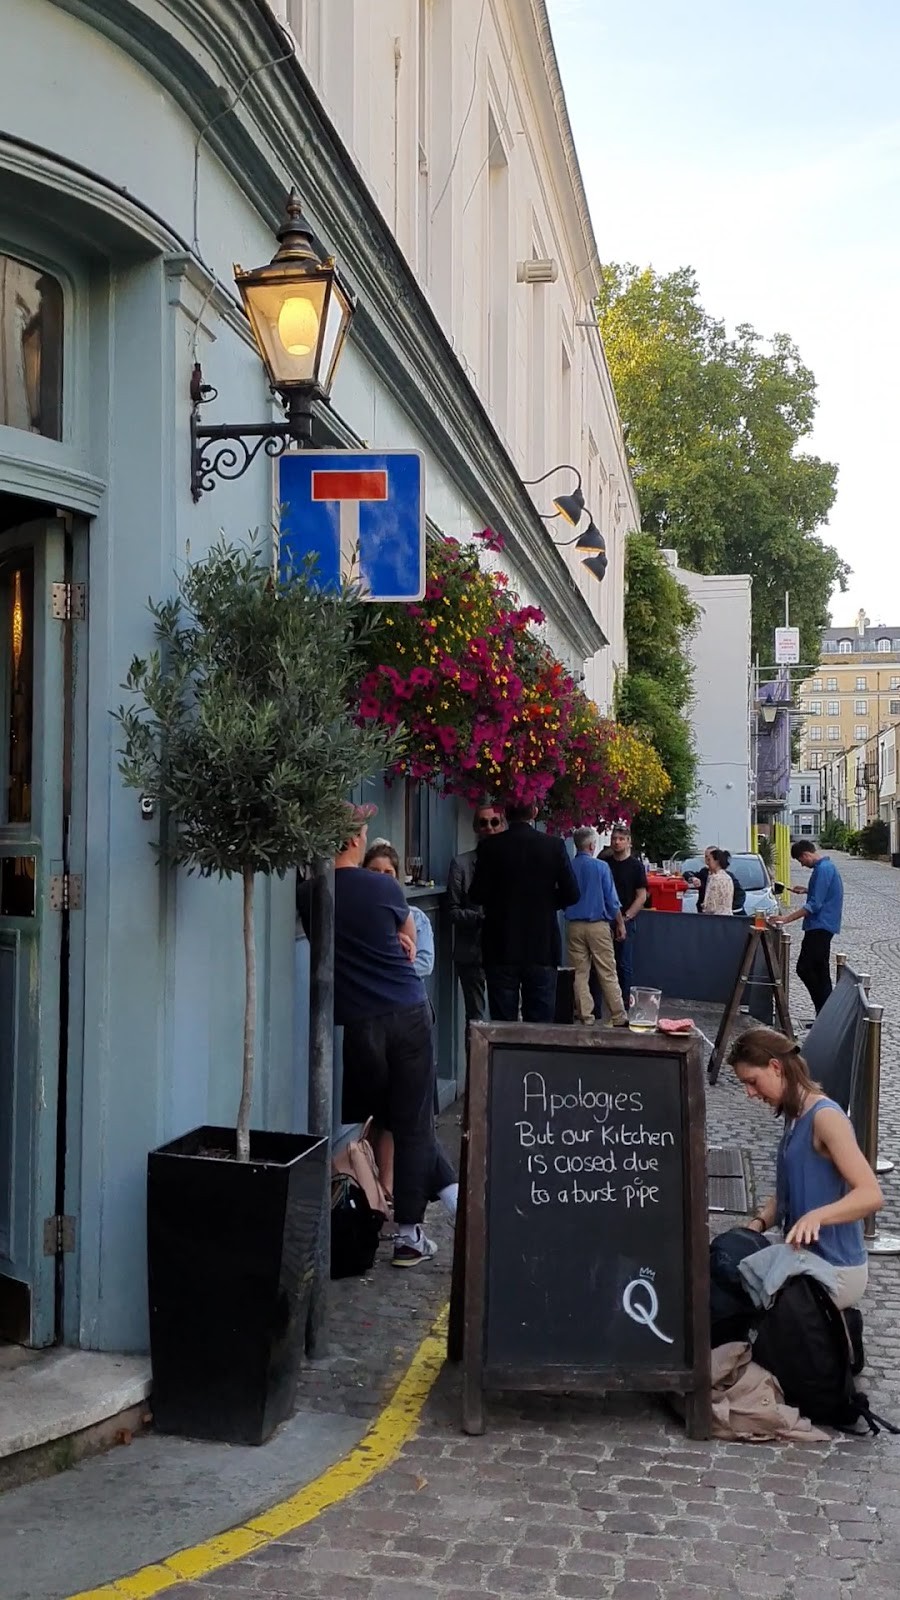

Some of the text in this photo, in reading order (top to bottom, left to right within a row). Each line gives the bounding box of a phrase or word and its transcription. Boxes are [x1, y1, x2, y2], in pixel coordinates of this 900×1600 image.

[523, 1071, 643, 1123] Apologies
[515, 1121, 554, 1146] But
[561, 1129, 594, 1145] our
[554, 1151, 617, 1173] closed
[623, 1151, 660, 1172] due
[531, 1177, 660, 1208] to a burst pipe
[623, 1279, 674, 1344] Q
